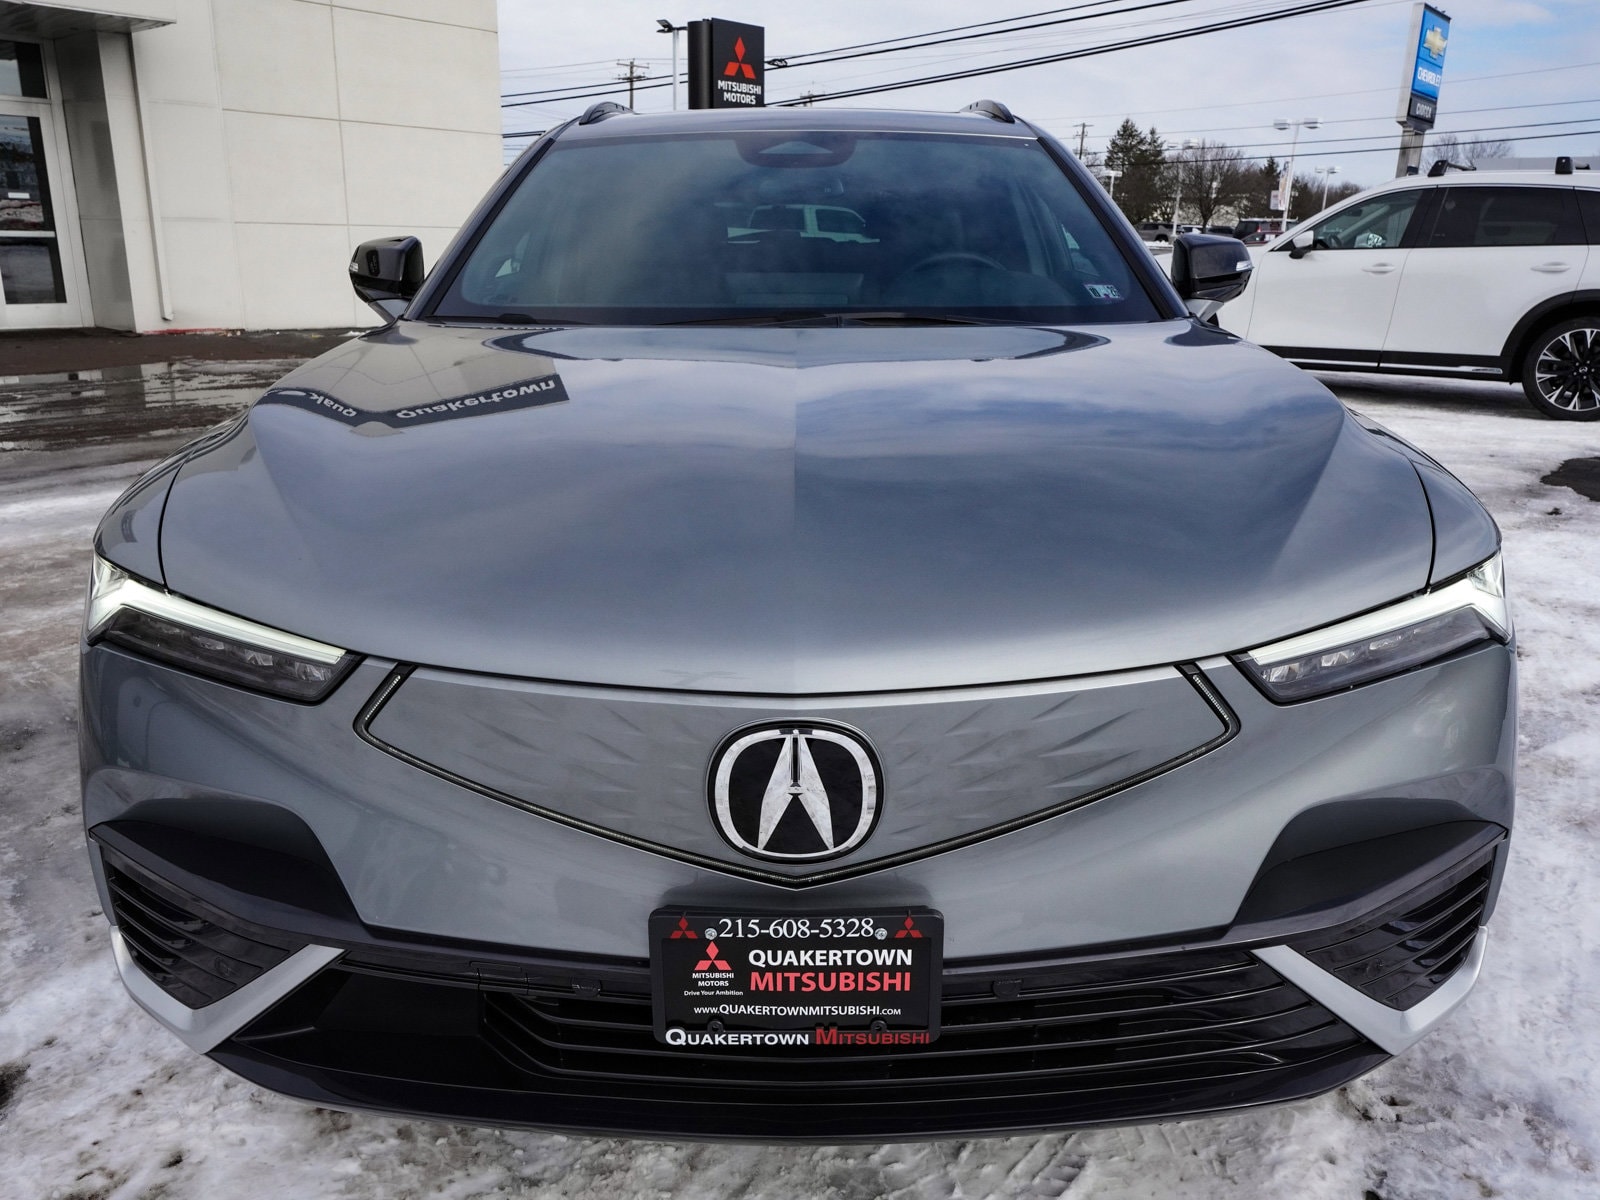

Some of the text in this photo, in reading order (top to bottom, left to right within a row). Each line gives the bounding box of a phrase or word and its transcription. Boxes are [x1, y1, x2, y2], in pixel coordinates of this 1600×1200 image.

[717, 80, 762, 95] MITSUBISHI
[723, 92, 756, 105] MOTORS
[719, 917, 874, 939] 215-608-5328
[748, 949, 912, 967] QUAKERTOWN
[750, 971, 911, 992] MITSUBISHI
[665, 1027, 931, 1046] QUAKERTOWN MITSUBISHI
